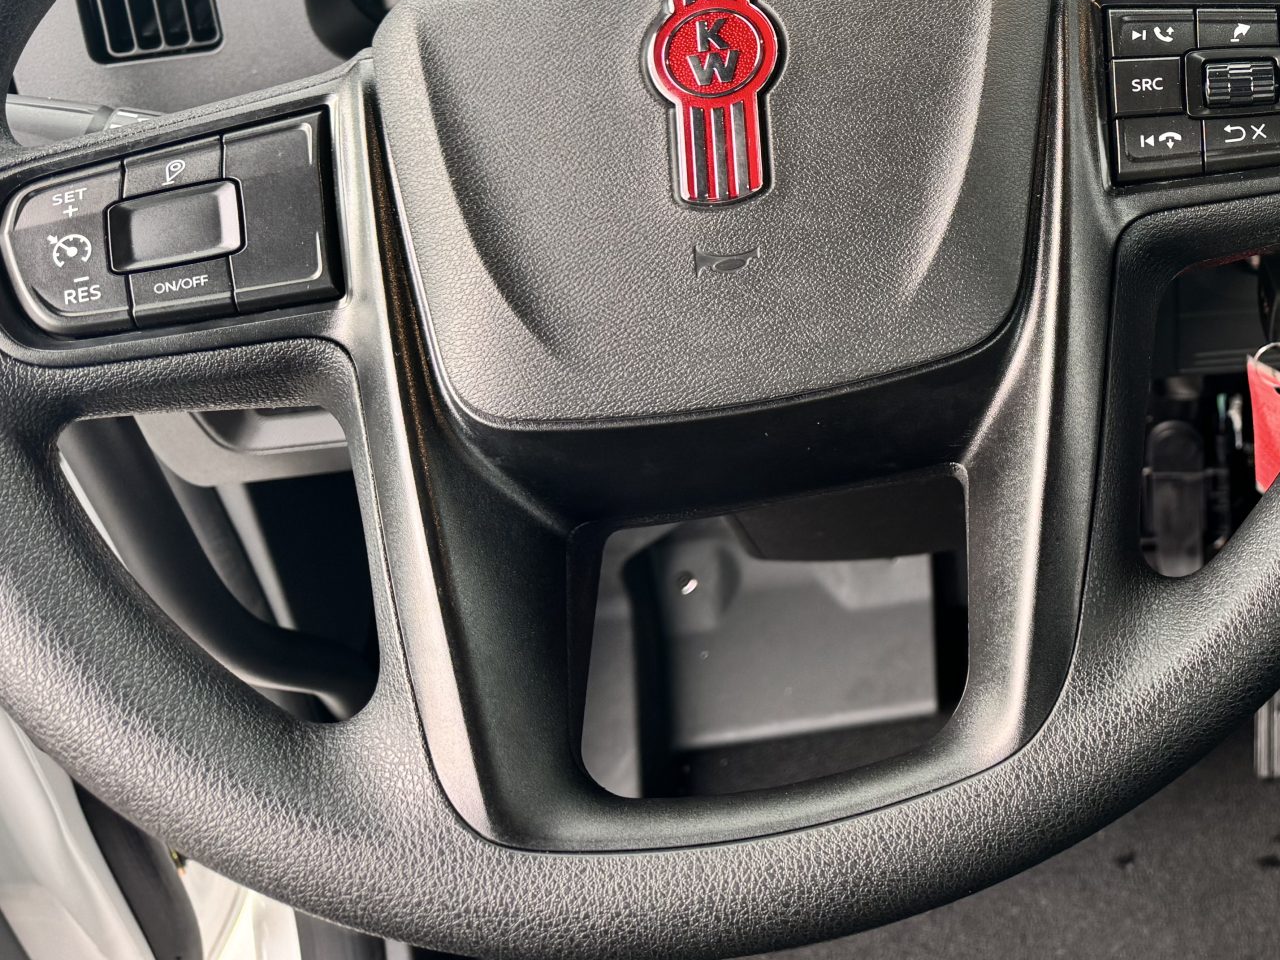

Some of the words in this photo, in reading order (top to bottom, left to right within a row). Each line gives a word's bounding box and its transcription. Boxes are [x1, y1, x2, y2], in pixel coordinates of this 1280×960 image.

[696, 18, 730, 52] K
[686, 49, 739, 86] W
[1131, 77, 1164, 92] SRC
[52, 188, 87, 206] SET
[153, 275, 209, 294] ON/OFF
[64, 285, 102, 306] RES
